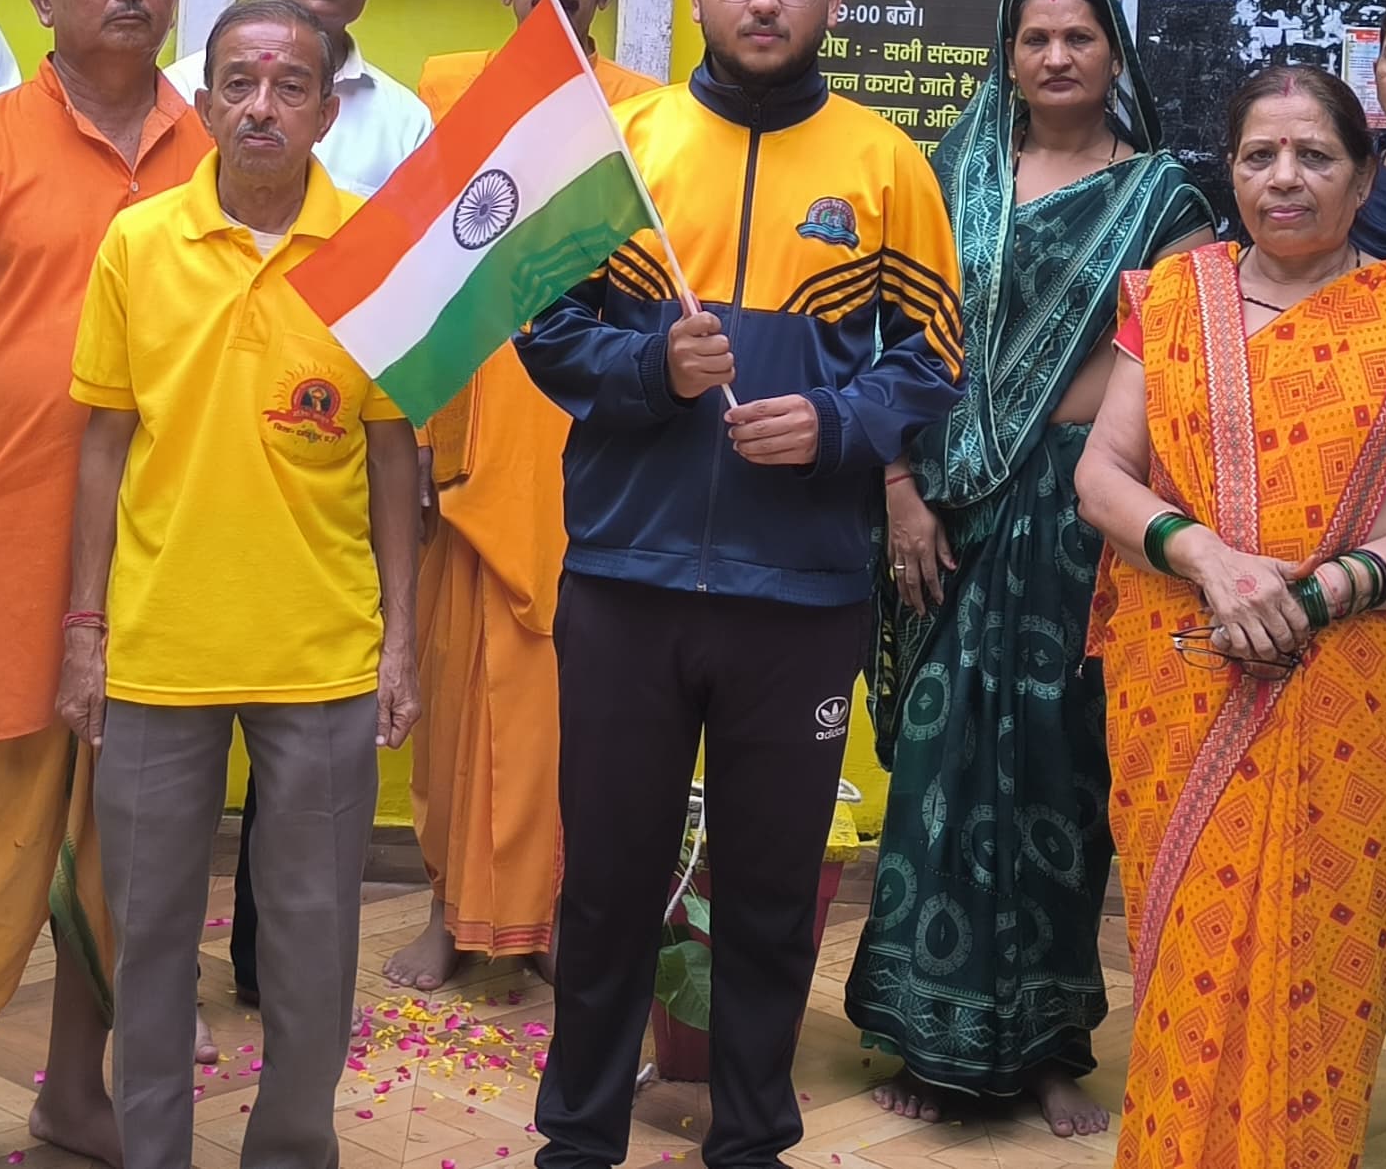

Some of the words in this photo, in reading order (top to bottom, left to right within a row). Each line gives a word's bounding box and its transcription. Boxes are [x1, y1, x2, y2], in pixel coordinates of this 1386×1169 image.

[884, 38, 923, 63] सभी
[927, 43, 989, 66] संस्कार
[864, 70, 915, 95] कराये
[919, 73, 957, 97] जाते
